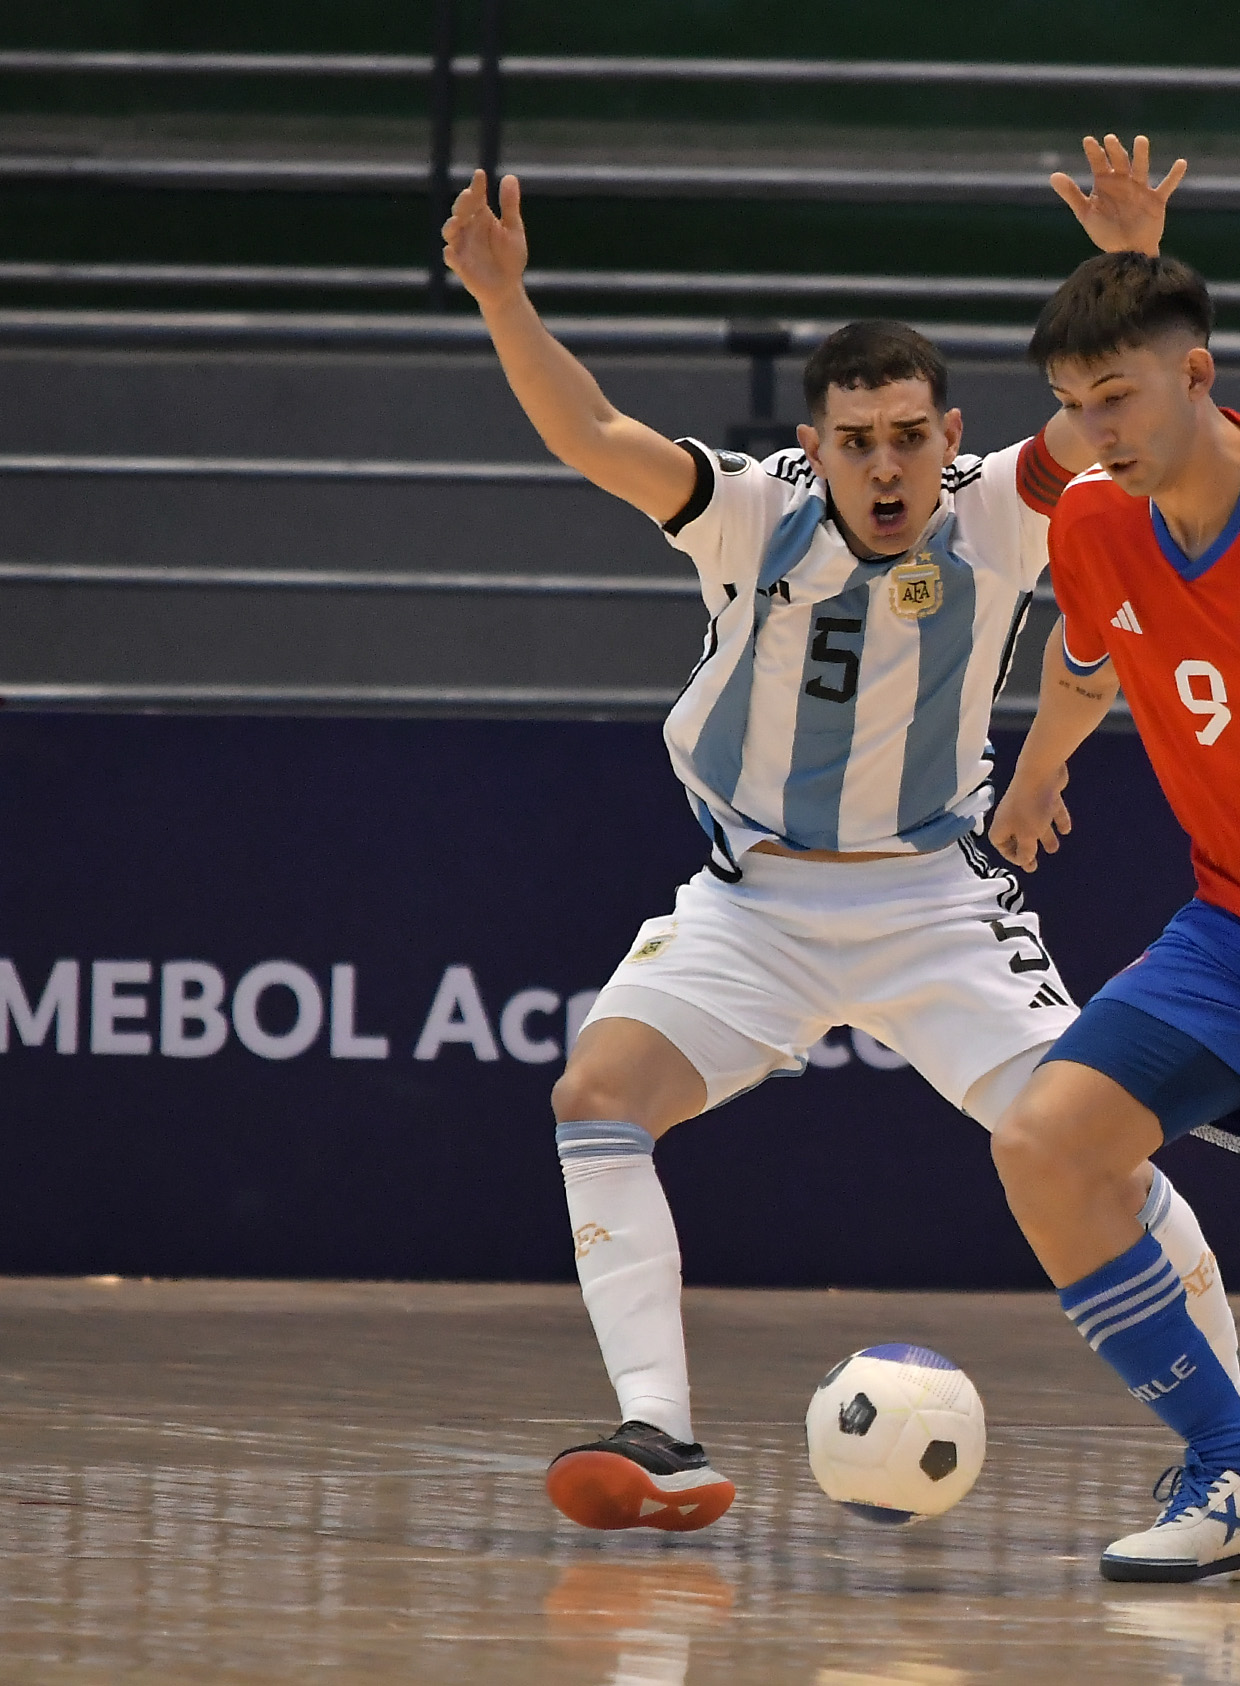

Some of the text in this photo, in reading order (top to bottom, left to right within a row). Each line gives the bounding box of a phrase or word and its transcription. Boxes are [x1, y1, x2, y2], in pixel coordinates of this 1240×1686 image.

[902, 580, 930, 604] AFA
[804, 616, 862, 704] 5
[1174, 660, 1232, 746] 9
